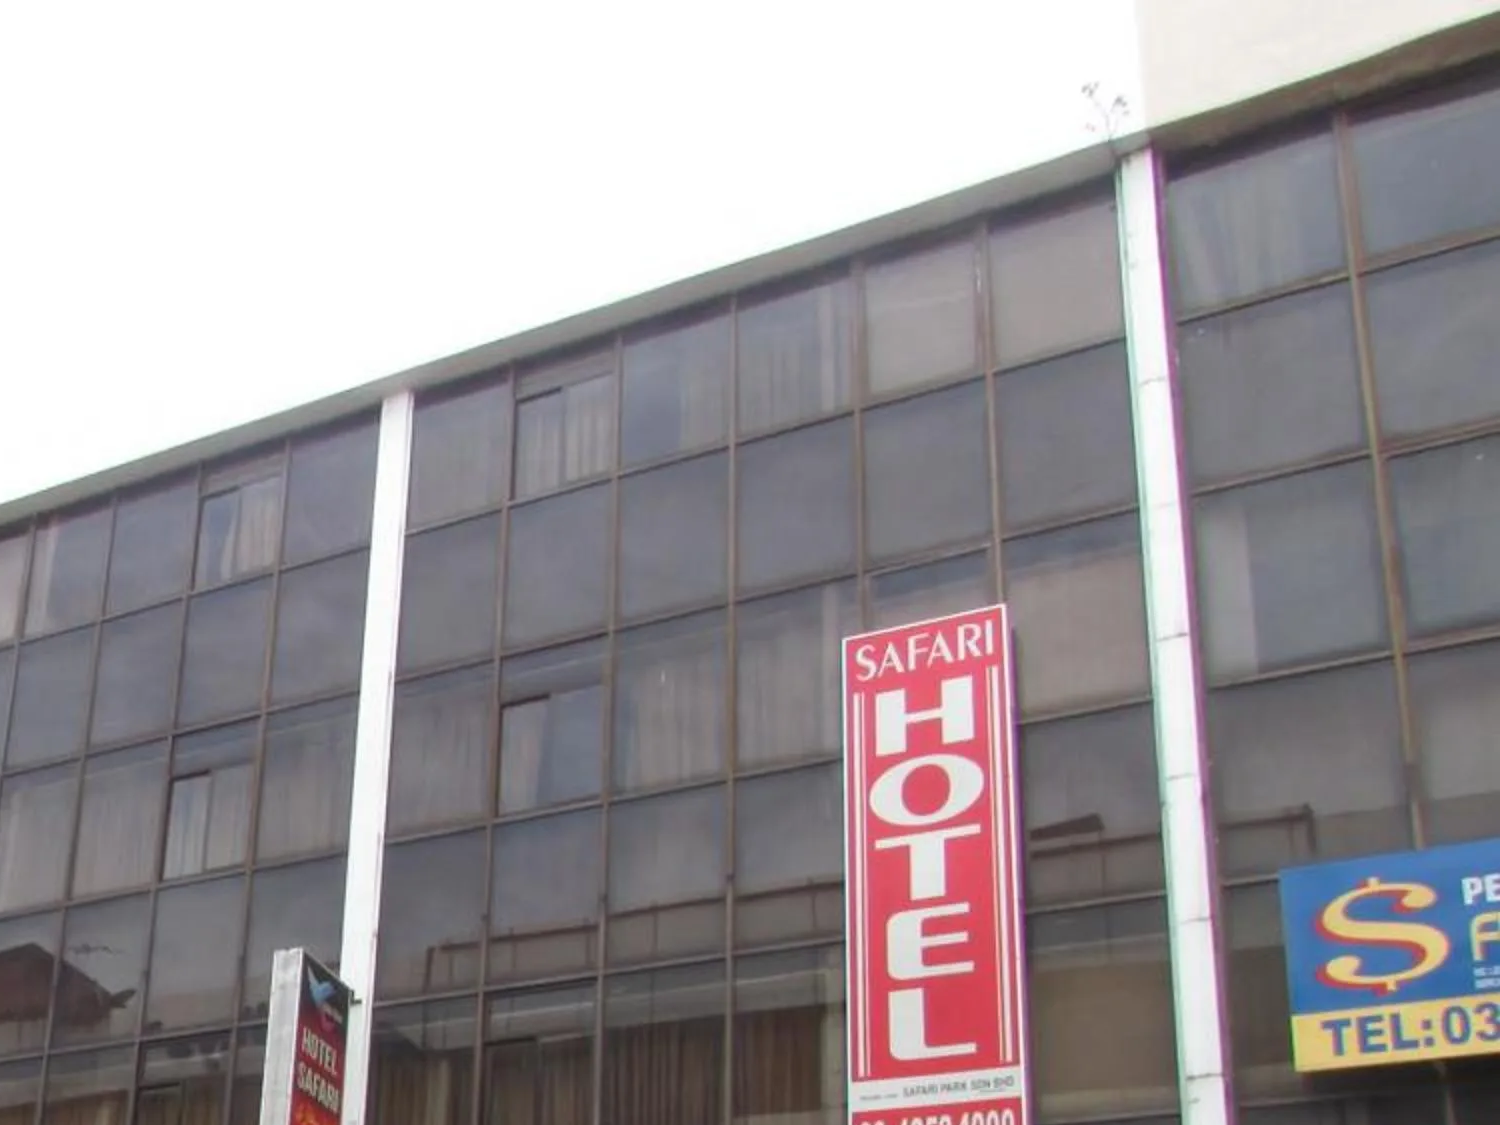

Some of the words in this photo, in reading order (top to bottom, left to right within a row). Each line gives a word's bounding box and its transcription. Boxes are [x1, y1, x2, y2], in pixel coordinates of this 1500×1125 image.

[855, 619, 994, 683] SAFARI
[870, 675, 984, 1062] HOTEL
[302, 1028, 337, 1075] HOTEL
[297, 1061, 340, 1115] SAFARI
[902, 1083, 938, 1098] SAFARI
[940, 1081, 967, 1093] PARK
